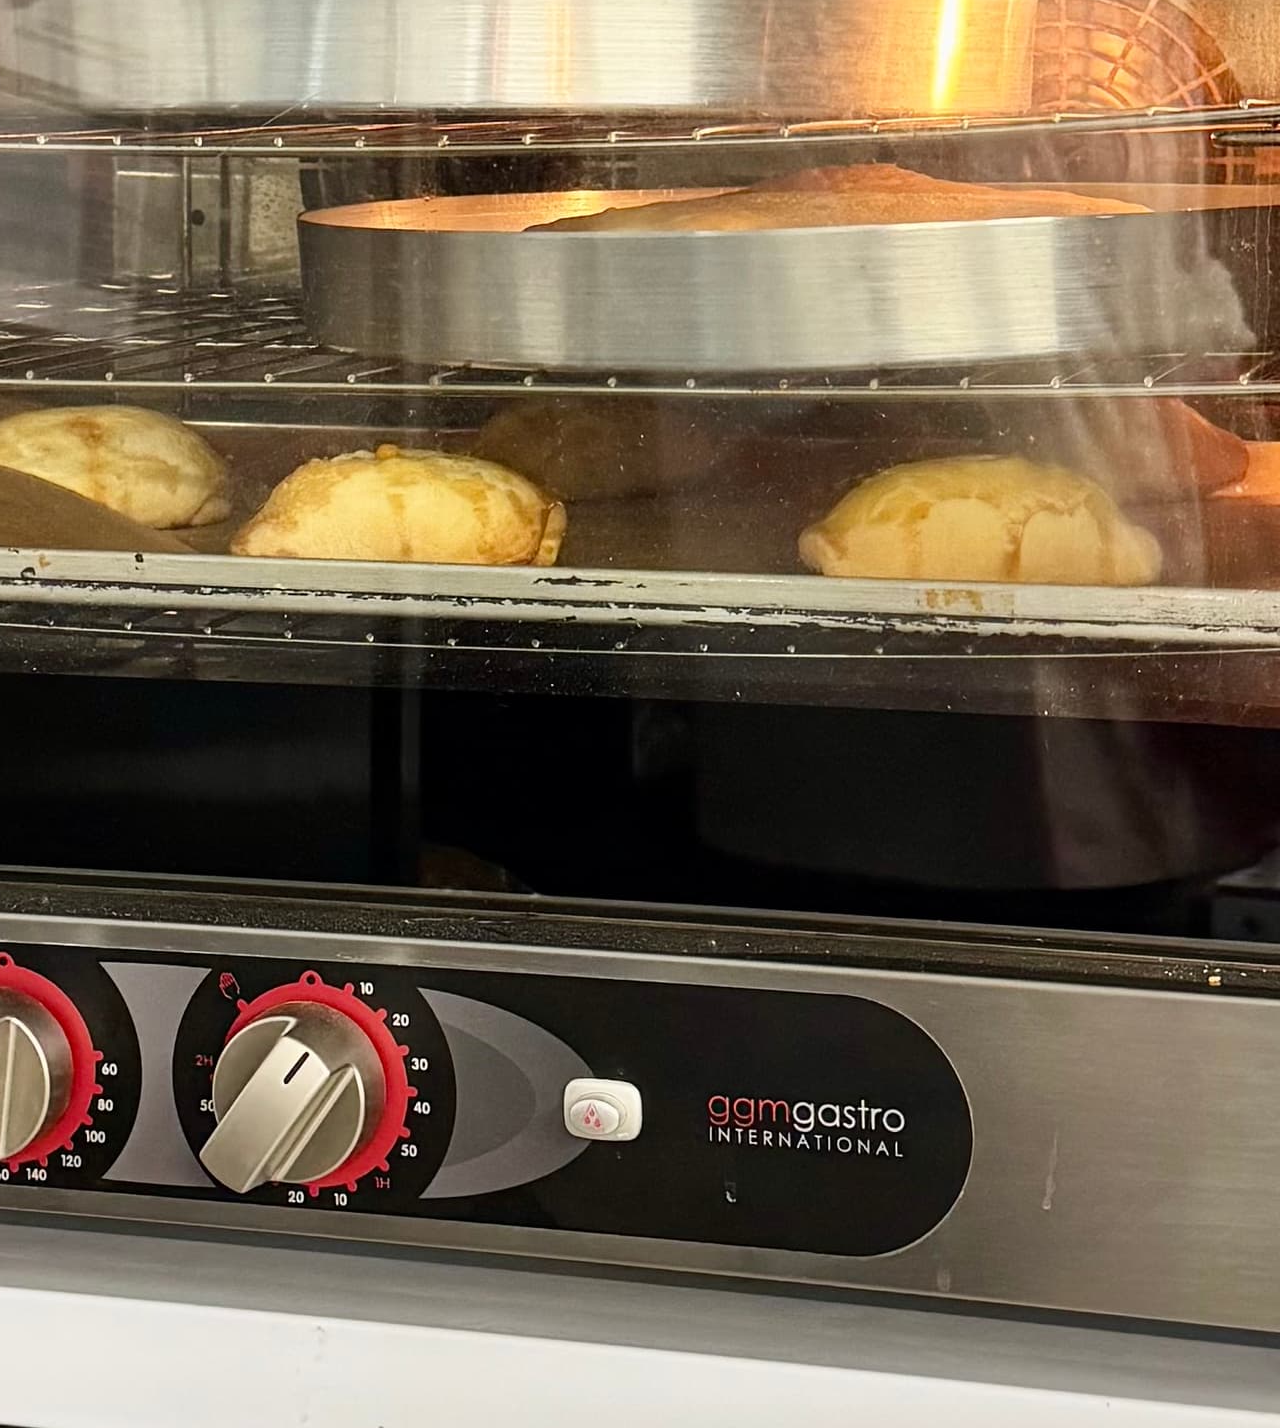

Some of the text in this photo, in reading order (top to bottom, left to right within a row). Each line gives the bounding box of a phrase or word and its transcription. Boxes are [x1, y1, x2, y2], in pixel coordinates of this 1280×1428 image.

[360, 982, 373, 995] 10
[392, 1013, 409, 1027] 20
[195, 1054, 213, 1066] 2H
[411, 1058, 428, 1071] 30
[101, 1063, 118, 1076] 60
[97, 1098, 113, 1112] 80
[413, 1101, 430, 1115] 40
[708, 1095, 906, 1133] ggmgastro
[85, 1130, 106, 1143] 100
[709, 1126, 904, 1157] INTERNATIONAL
[401, 1144, 418, 1157] 50
[61, 1154, 82, 1168] 120
[26, 1167, 47, 1181] 140
[288, 1190, 304, 1204] 20
[333, 1193, 348, 1206] 10
